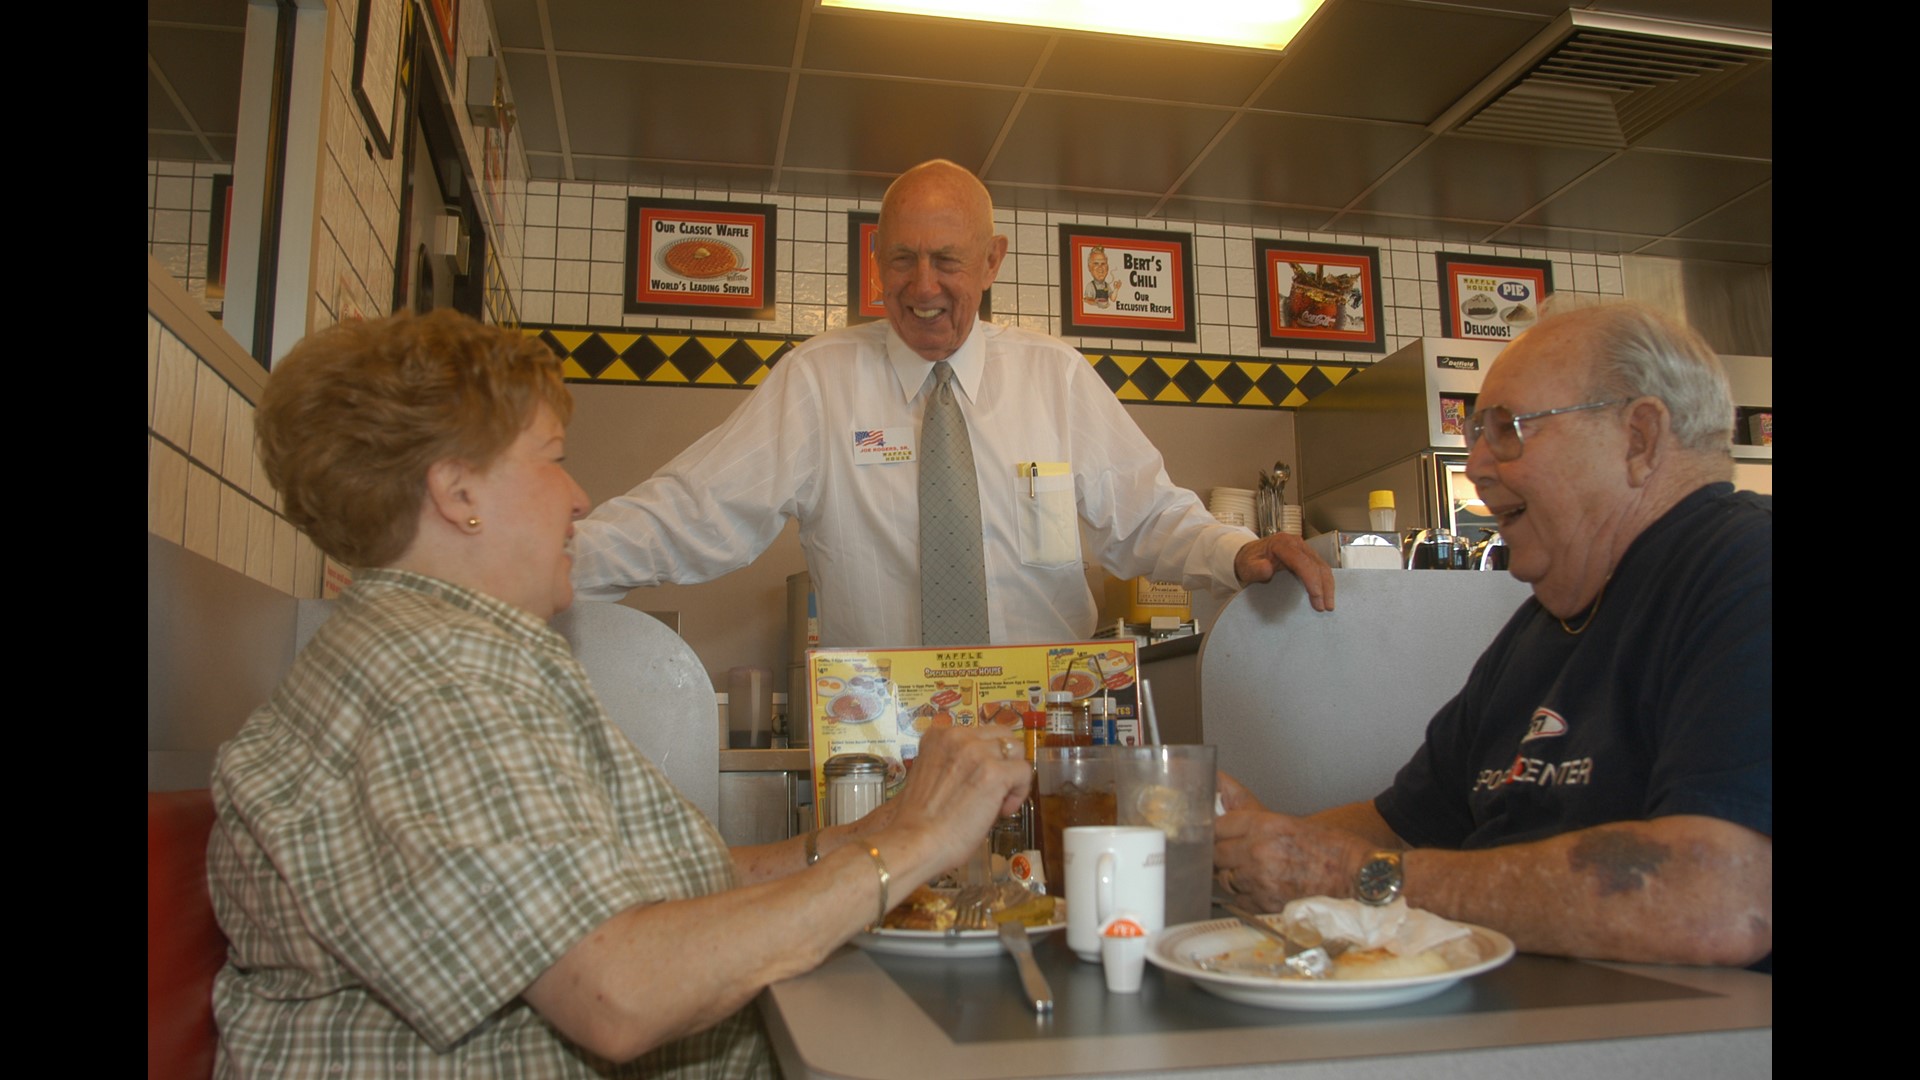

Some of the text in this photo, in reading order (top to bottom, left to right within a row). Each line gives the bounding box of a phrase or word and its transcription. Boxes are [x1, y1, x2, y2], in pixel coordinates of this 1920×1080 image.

[655, 221, 749, 238] OUR CLASSIC WAFFLE
[1123, 253, 1162, 272] BERT'S
[1129, 270, 1157, 288] CHILI
[1463, 278, 1497, 286] WAFFLE
[651, 279, 750, 294] WORLD'S LEADING SERVER
[1466, 284, 1495, 292] HOUSE
[1502, 283, 1525, 297] PIE
[1134, 291, 1149, 302] OUR
[1116, 301, 1172, 314] EXCLUSIVE RECIPE
[1464, 320, 1511, 337] DELICIOUS!
[936, 652, 983, 660] WAFFLE
[941, 660, 979, 668] HOUSE
[967, 669, 978, 677] THE
[978, 666, 1003, 676] HOUSE
